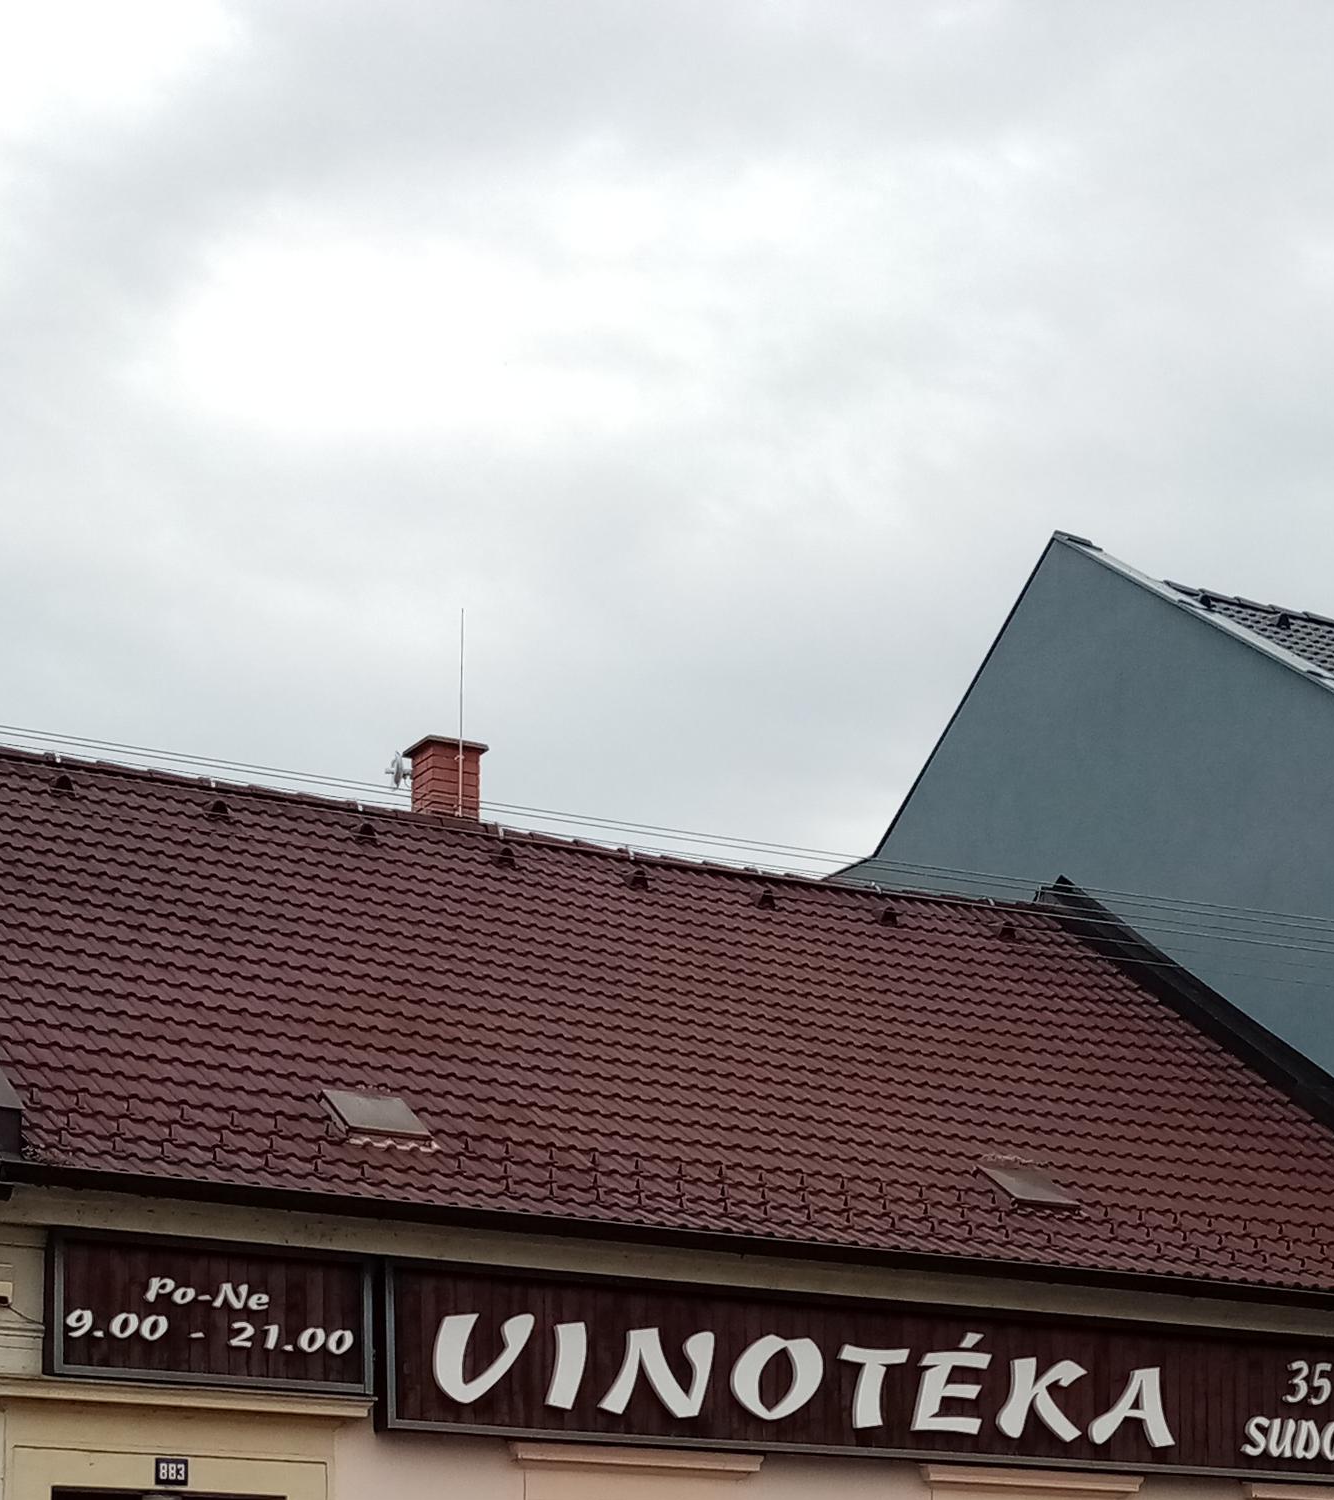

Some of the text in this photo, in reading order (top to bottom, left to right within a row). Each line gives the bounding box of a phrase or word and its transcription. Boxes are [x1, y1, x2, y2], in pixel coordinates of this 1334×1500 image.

[144, 1276, 270, 1311] Po-Ne
[66, 1308, 168, 1341] 9.00
[228, 1321, 354, 1355] 21.00
[432, 1313, 1176, 1448] VINOTÉKA
[1282, 1360, 1333, 1405] 35
[159, 1462, 185, 1480] 883
